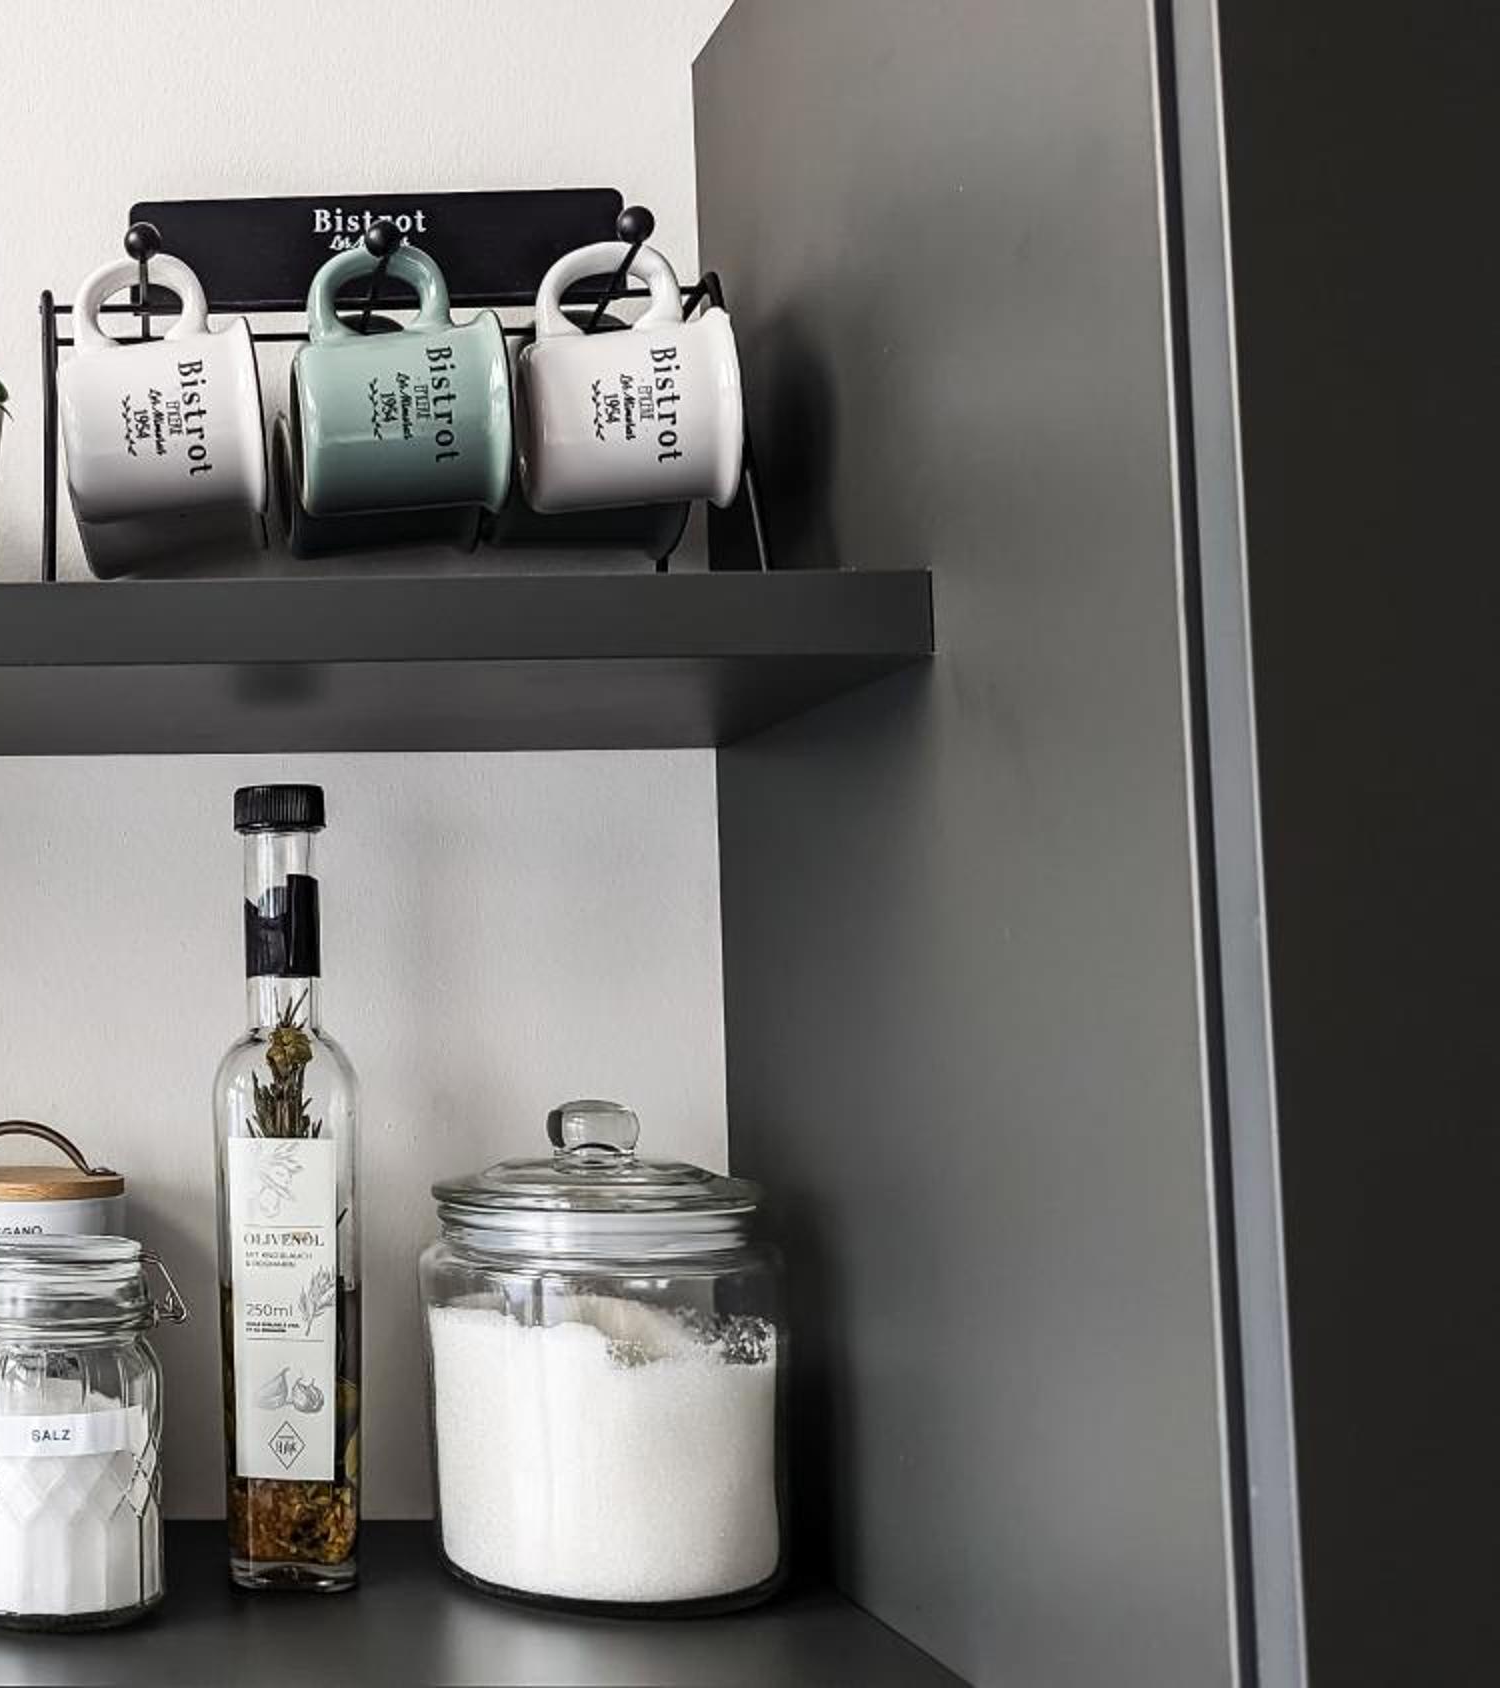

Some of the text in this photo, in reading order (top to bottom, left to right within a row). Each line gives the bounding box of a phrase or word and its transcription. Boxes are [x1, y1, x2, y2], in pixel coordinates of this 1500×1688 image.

[178, 359, 213, 476] Bistrot
[380, 391, 399, 422] 1954
[426, 345, 459, 463] Bistrot
[603, 393, 621, 424] 1954
[650, 346, 682, 463] Bistrot
[133, 409, 150, 439] 1954
[246, 1303, 293, 1317] 250ml
[31, 1429, 71, 1442] SALZ
